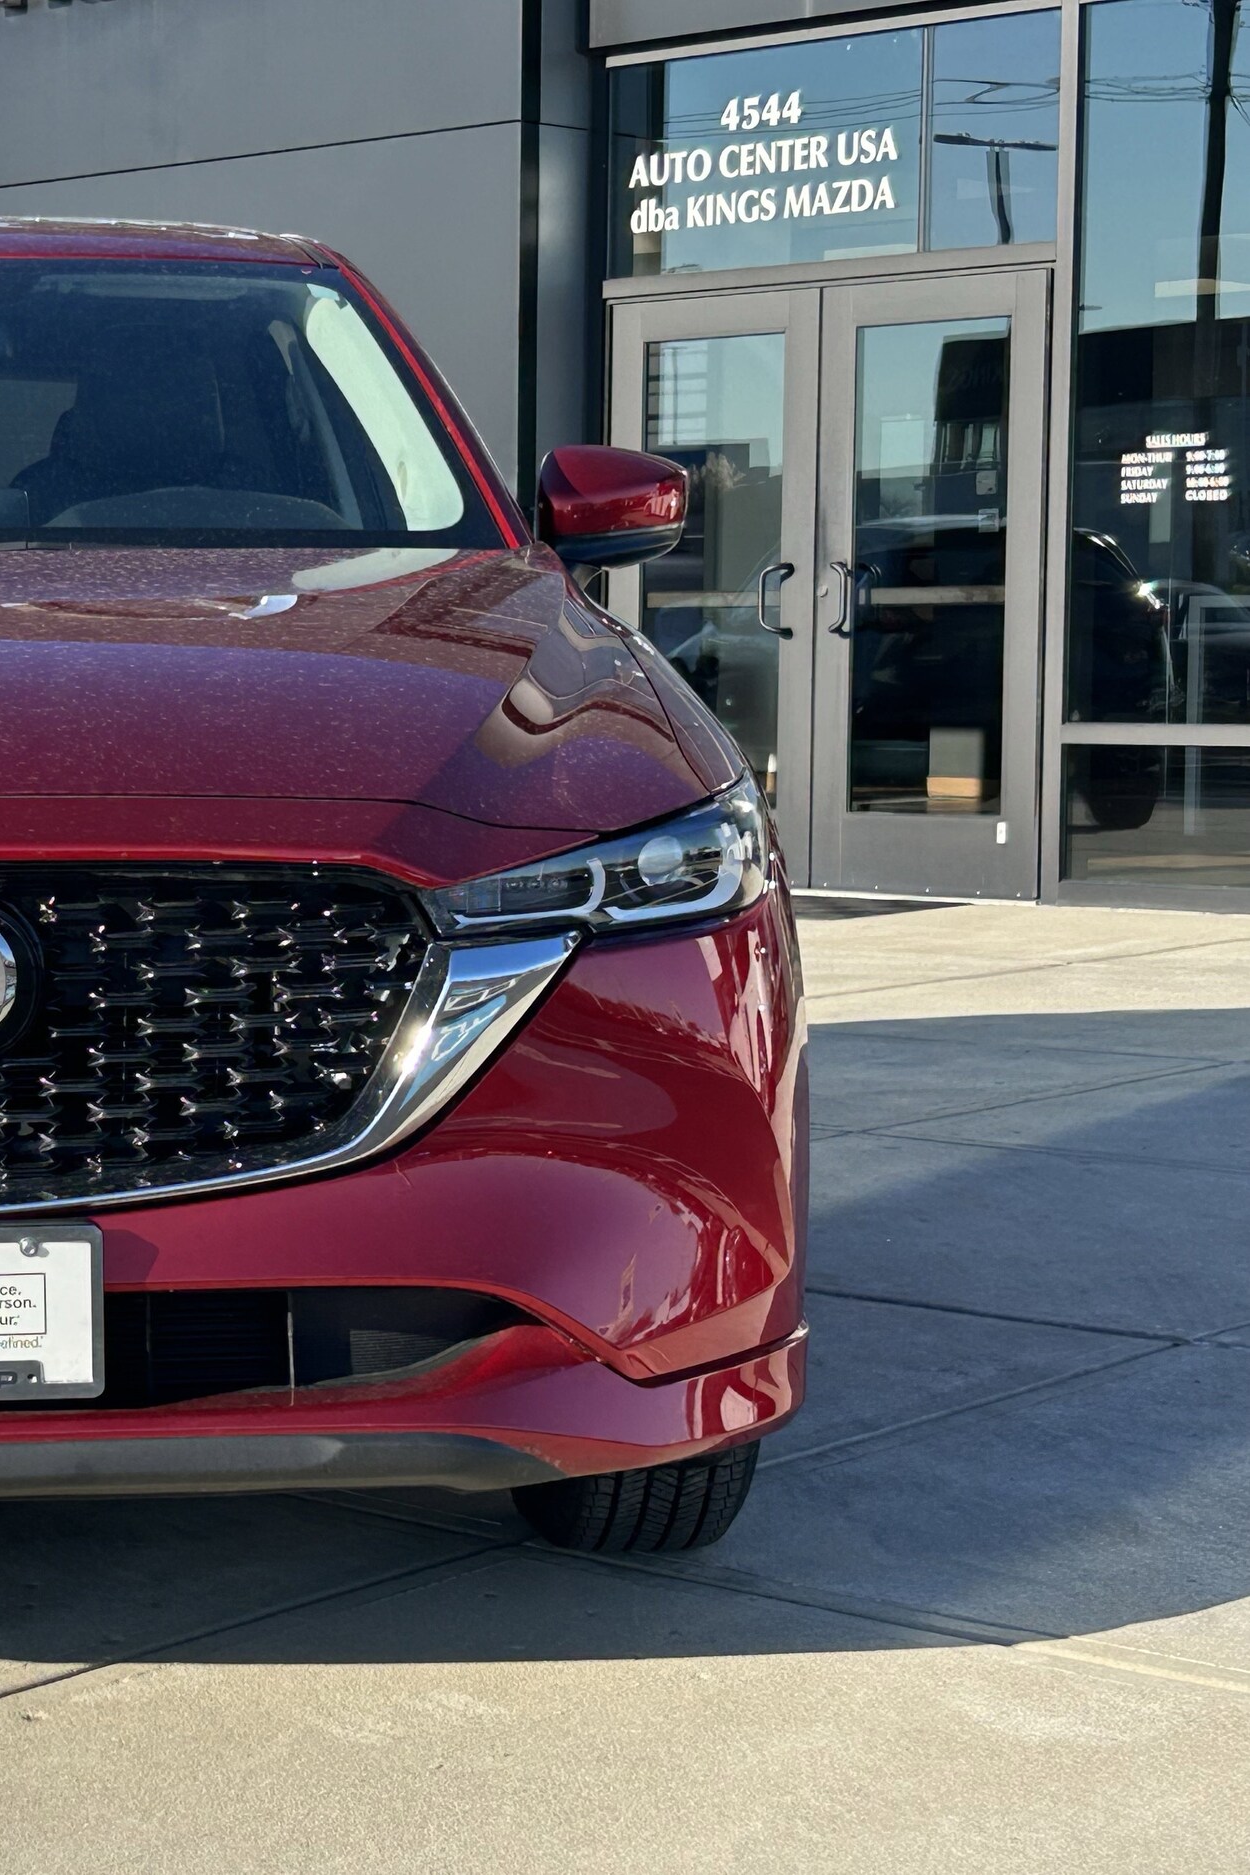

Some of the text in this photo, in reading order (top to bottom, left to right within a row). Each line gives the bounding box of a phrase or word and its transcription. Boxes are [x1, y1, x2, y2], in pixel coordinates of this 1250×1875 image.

[720, 89, 801, 131] 4544
[628, 126, 898, 188] AUTO CENTER USA
[630, 175, 895, 234] dba KINGS MAZDA
[1145, 432, 1206, 449] SALES HOURS
[1121, 465, 1154, 478] FRIDAY
[1121, 478, 1169, 491] SATURDAY
[1121, 488, 1229, 504] SUNDAY CLOSED
